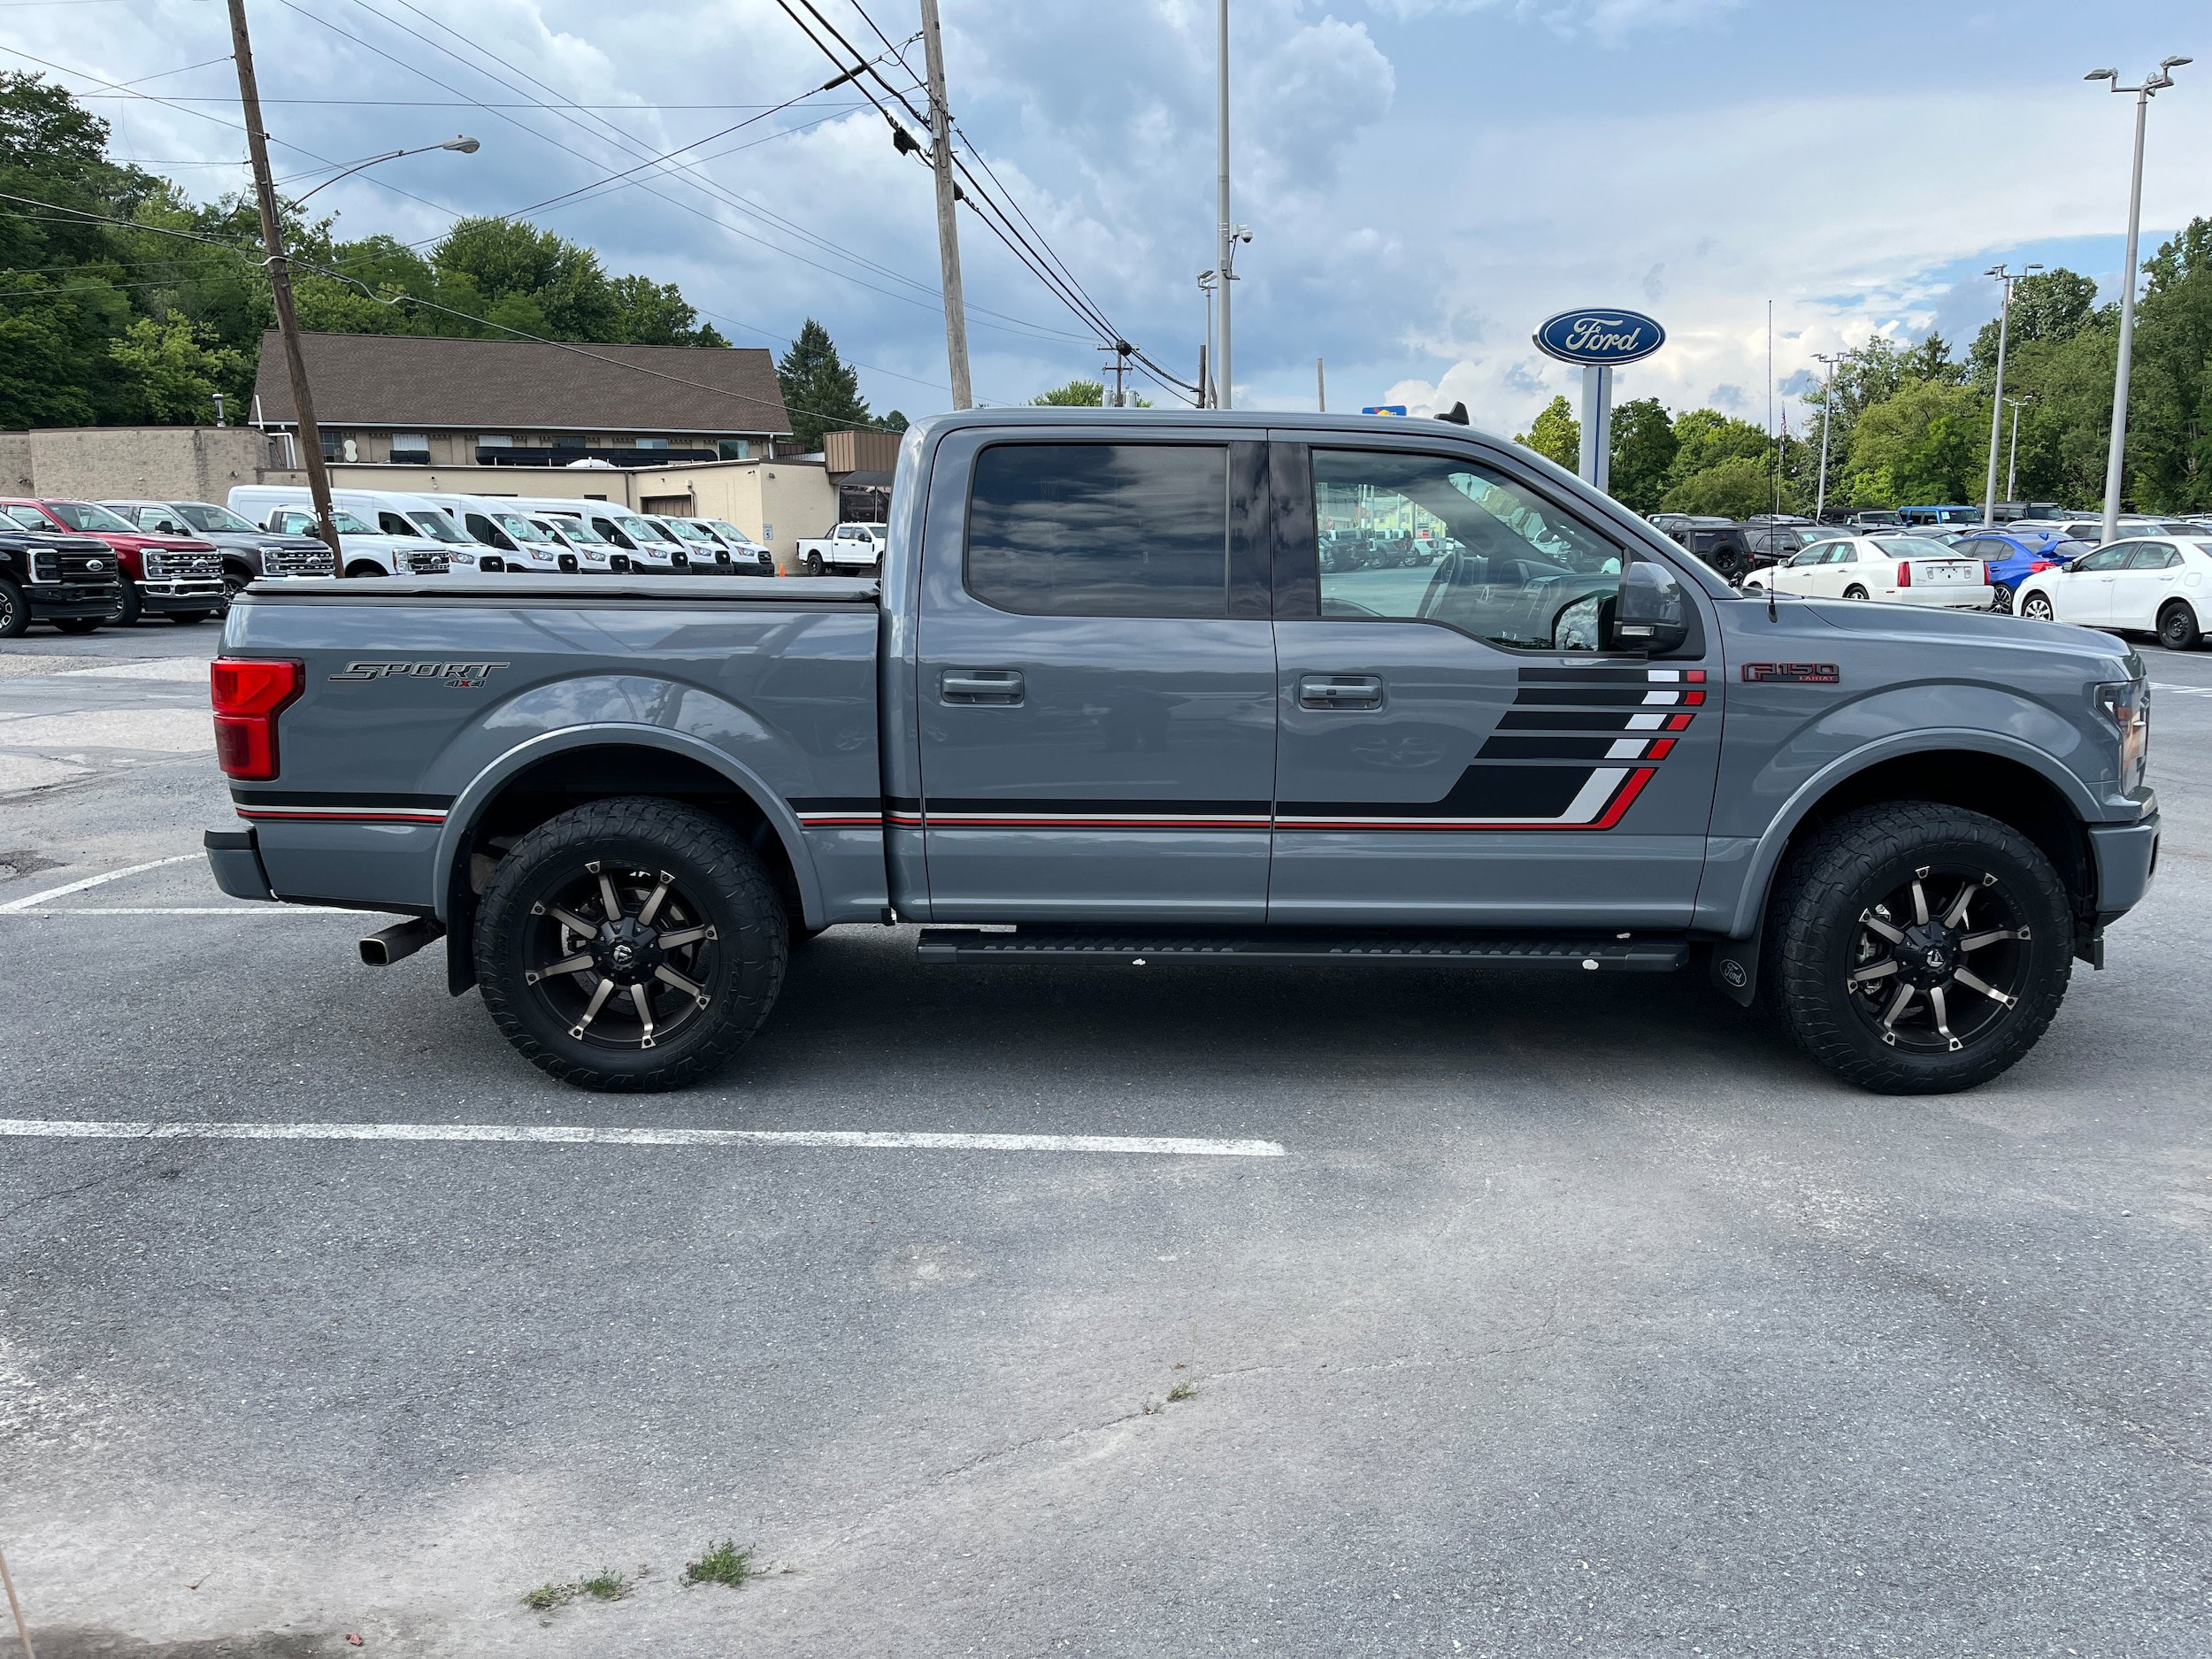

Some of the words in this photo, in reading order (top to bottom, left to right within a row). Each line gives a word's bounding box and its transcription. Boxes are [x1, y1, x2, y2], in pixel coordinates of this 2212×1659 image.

[1565, 317, 1642, 351] Ford
[327, 661, 511, 682] SPORT
[1724, 962, 1741, 984] Ford
